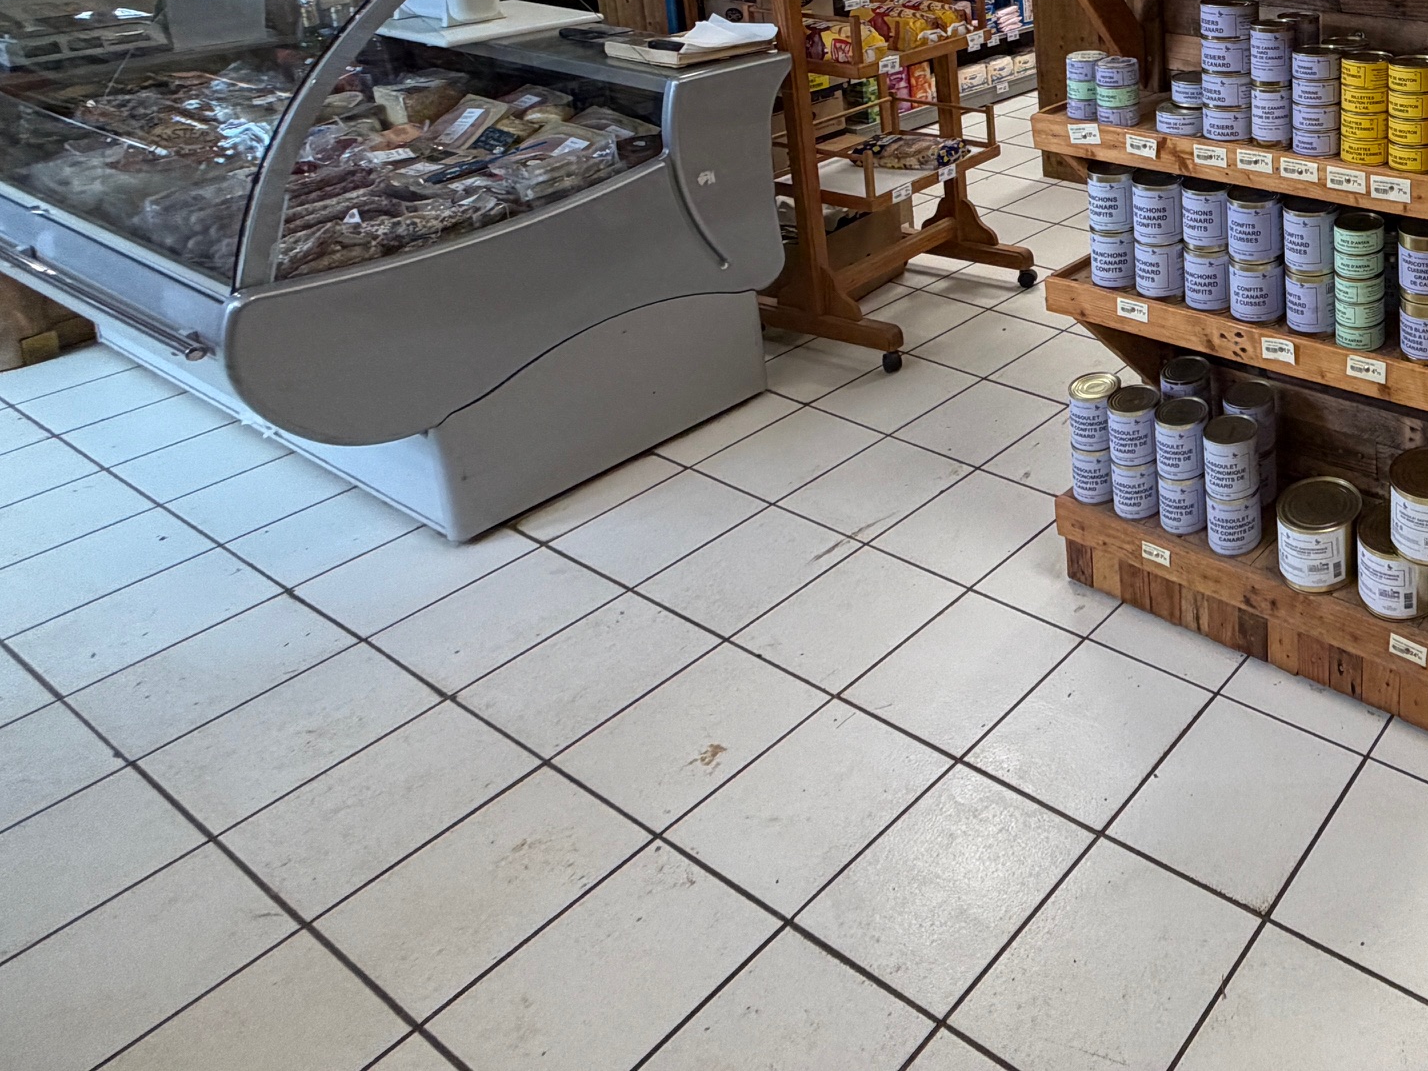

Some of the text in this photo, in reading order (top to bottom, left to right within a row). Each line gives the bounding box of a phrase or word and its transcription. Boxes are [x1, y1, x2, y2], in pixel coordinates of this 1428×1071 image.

[1204, 53, 1226, 61] GESIERS
[1207, 59, 1231, 68] CANARD
[1139, 213, 1167, 221] CANARD
[1186, 216, 1214, 224] CANARD
[1135, 220, 1162, 229] CONFITS
[1231, 220, 1256, 229] CONFITS
[1233, 235, 1259, 243] CUISSES
[1095, 265, 1123, 273] CONFITS
[1190, 279, 1218, 287] CANARD
[1187, 285, 1213, 295] CONFITS
[1113, 440, 1138, 448] CONFITS
[1113, 446, 1136, 454] CANARD
[1210, 474, 1235, 482] CONFITS
[1209, 479, 1233, 489] CANARD
[1119, 493, 1143, 501] CONFITS
[1118, 499, 1141, 507] CANARD
[1213, 515, 1249, 524] CASSOULET
